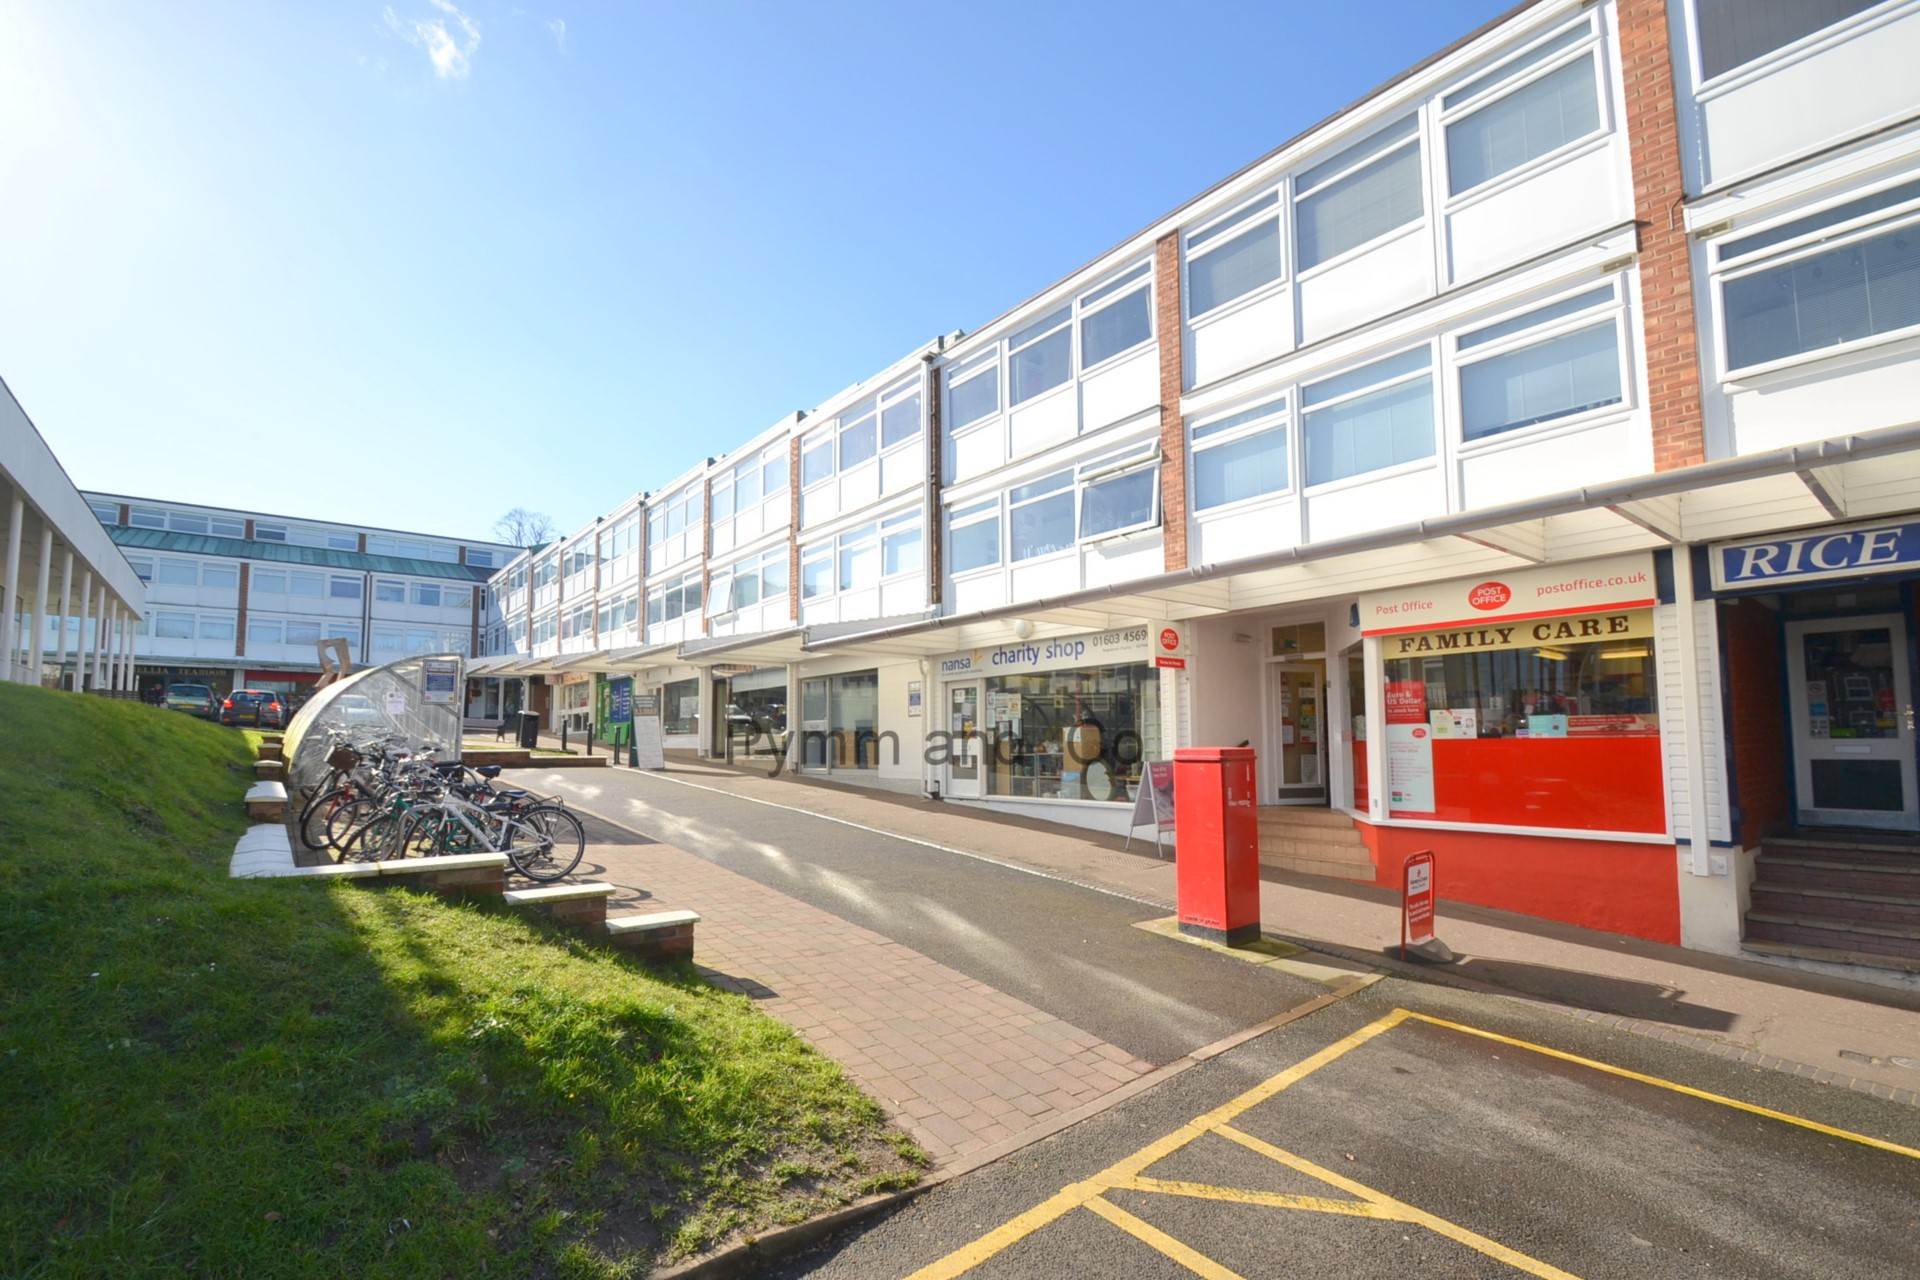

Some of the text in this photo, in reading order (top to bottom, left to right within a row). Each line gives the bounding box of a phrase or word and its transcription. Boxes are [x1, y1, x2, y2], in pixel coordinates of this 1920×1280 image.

[1733, 527, 1903, 579] RICE
[1477, 586, 1503, 596] POST
[1536, 571, 1647, 597] postoffice.co.uk
[1376, 599, 1433, 615] Post Office
[1472, 594, 1507, 606] OFFICE
[1092, 629, 1148, 647] 01603 4569
[1399, 615, 1629, 653] FAMILY CARE
[942, 637, 1085, 672] nansa charity shop
